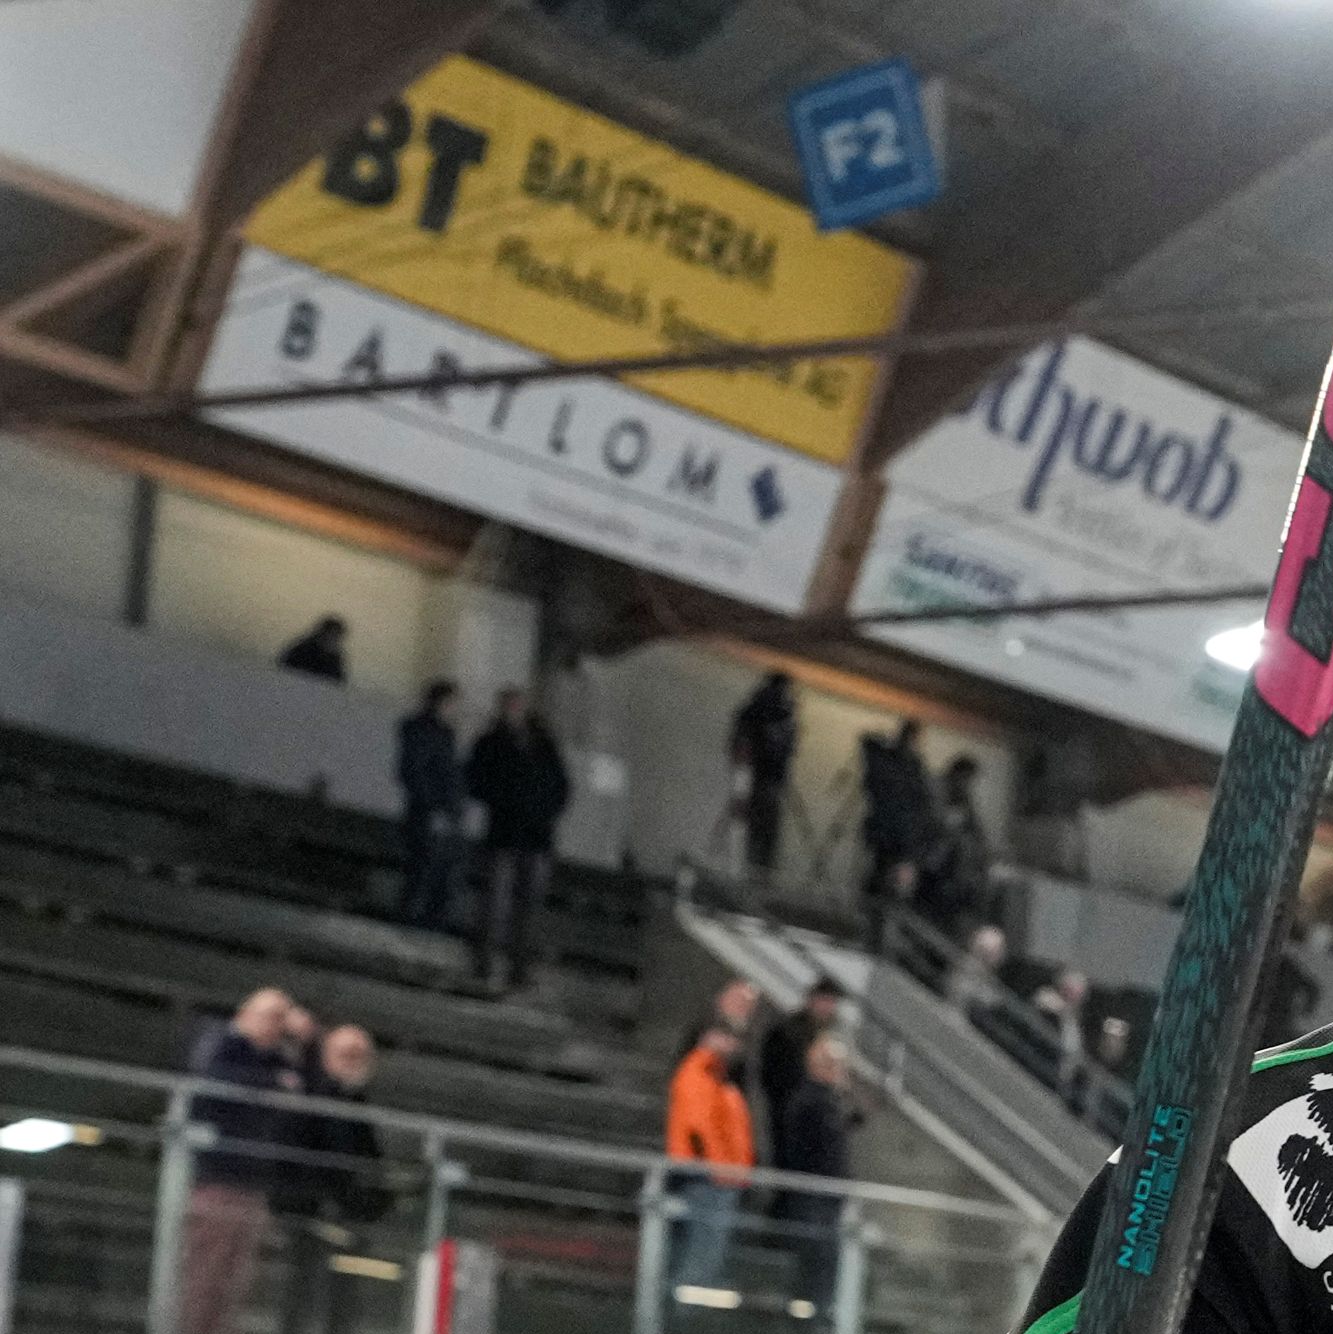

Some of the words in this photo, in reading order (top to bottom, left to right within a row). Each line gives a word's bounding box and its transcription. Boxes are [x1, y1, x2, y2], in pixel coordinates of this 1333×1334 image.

[320, 98, 491, 235] BT
[518, 134, 778, 295] BAUTHERM
[822, 108, 902, 182] F2
[1116, 1103, 1174, 1270] NANOLITE
